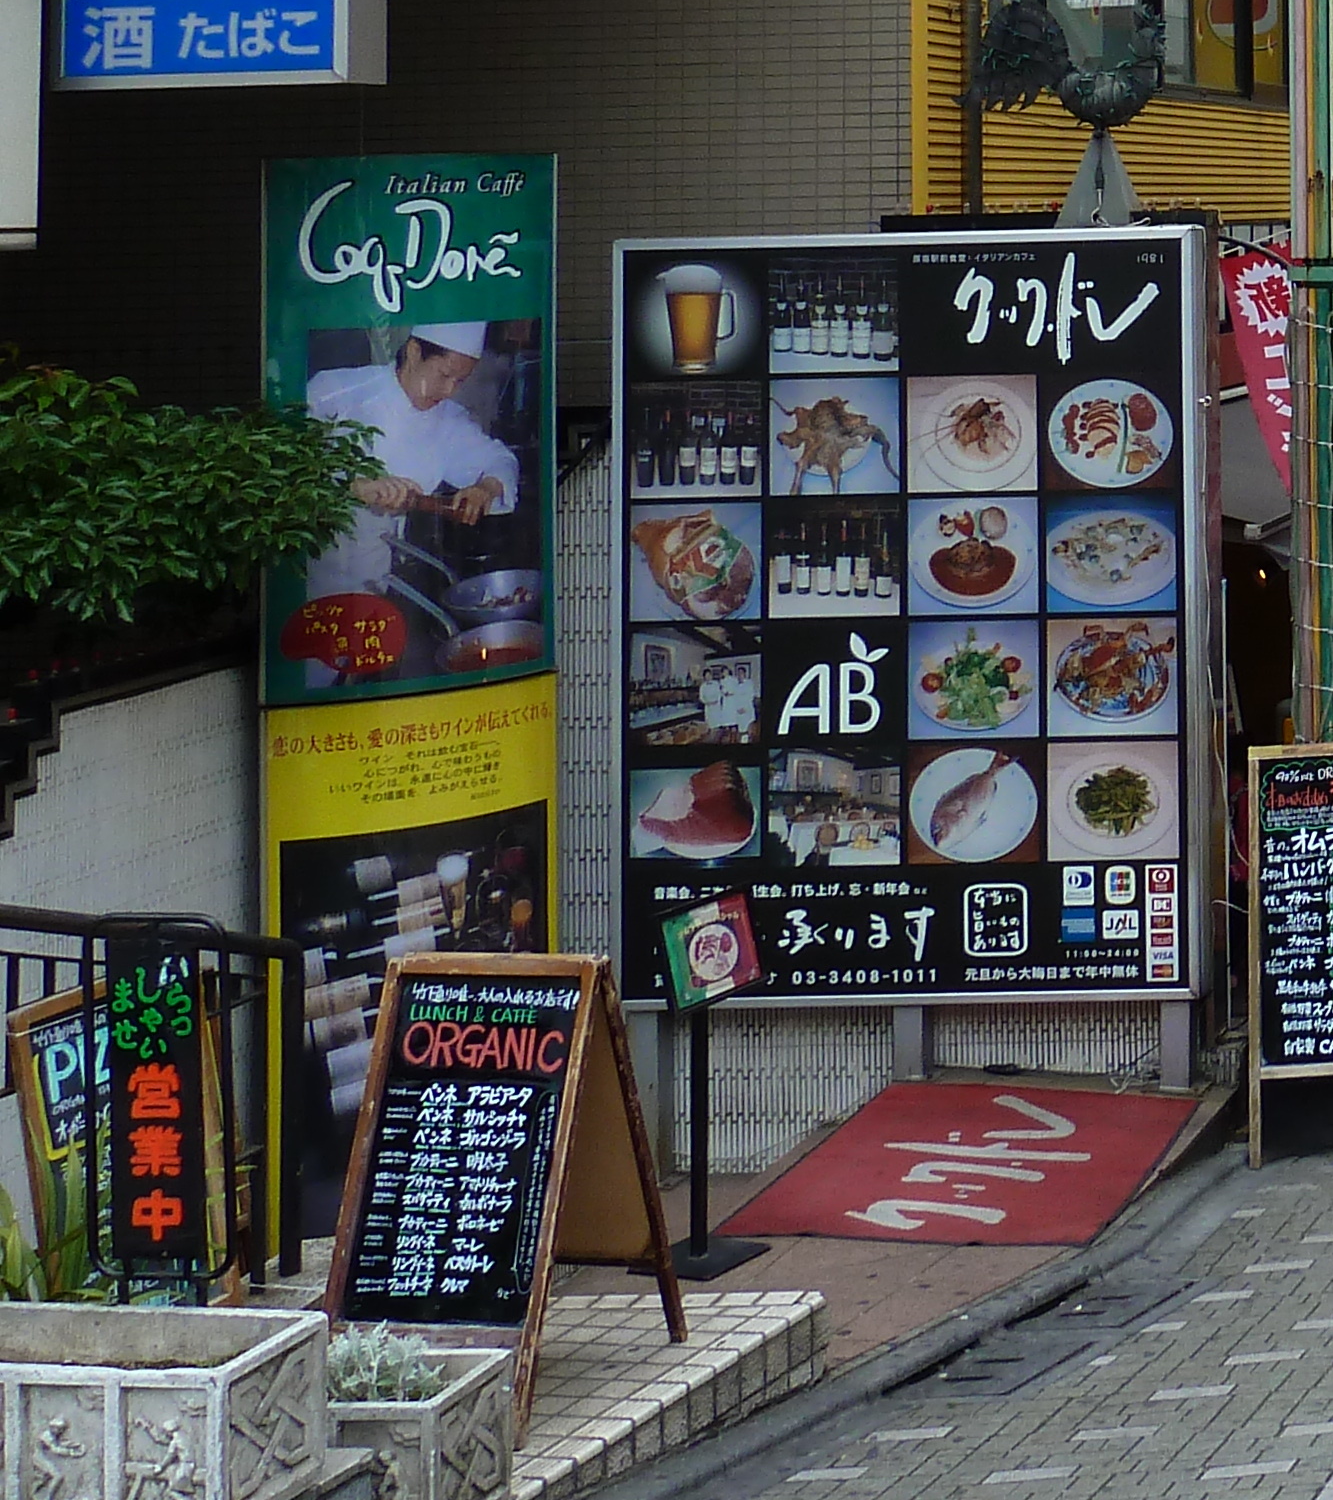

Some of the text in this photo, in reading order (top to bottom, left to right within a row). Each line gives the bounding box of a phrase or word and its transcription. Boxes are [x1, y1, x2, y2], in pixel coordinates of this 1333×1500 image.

[82, 6, 320, 70] 酒 たばこ
[385, 173, 467, 195] Italian
[1105, 917, 1137, 932] JAL
[1152, 952, 1174, 960] VISA
[791, 968, 937, 985] 03-3408-1011
[410, 1003, 469, 1022] LUNCH
[473, 1005, 486, 1023] &
[402, 1020, 564, 1073] ORGANIC
[127, 1062, 184, 1242] 営業中
[466, 1151, 509, 1173] 明太子
[452, 1237, 484, 1252] マーレ
